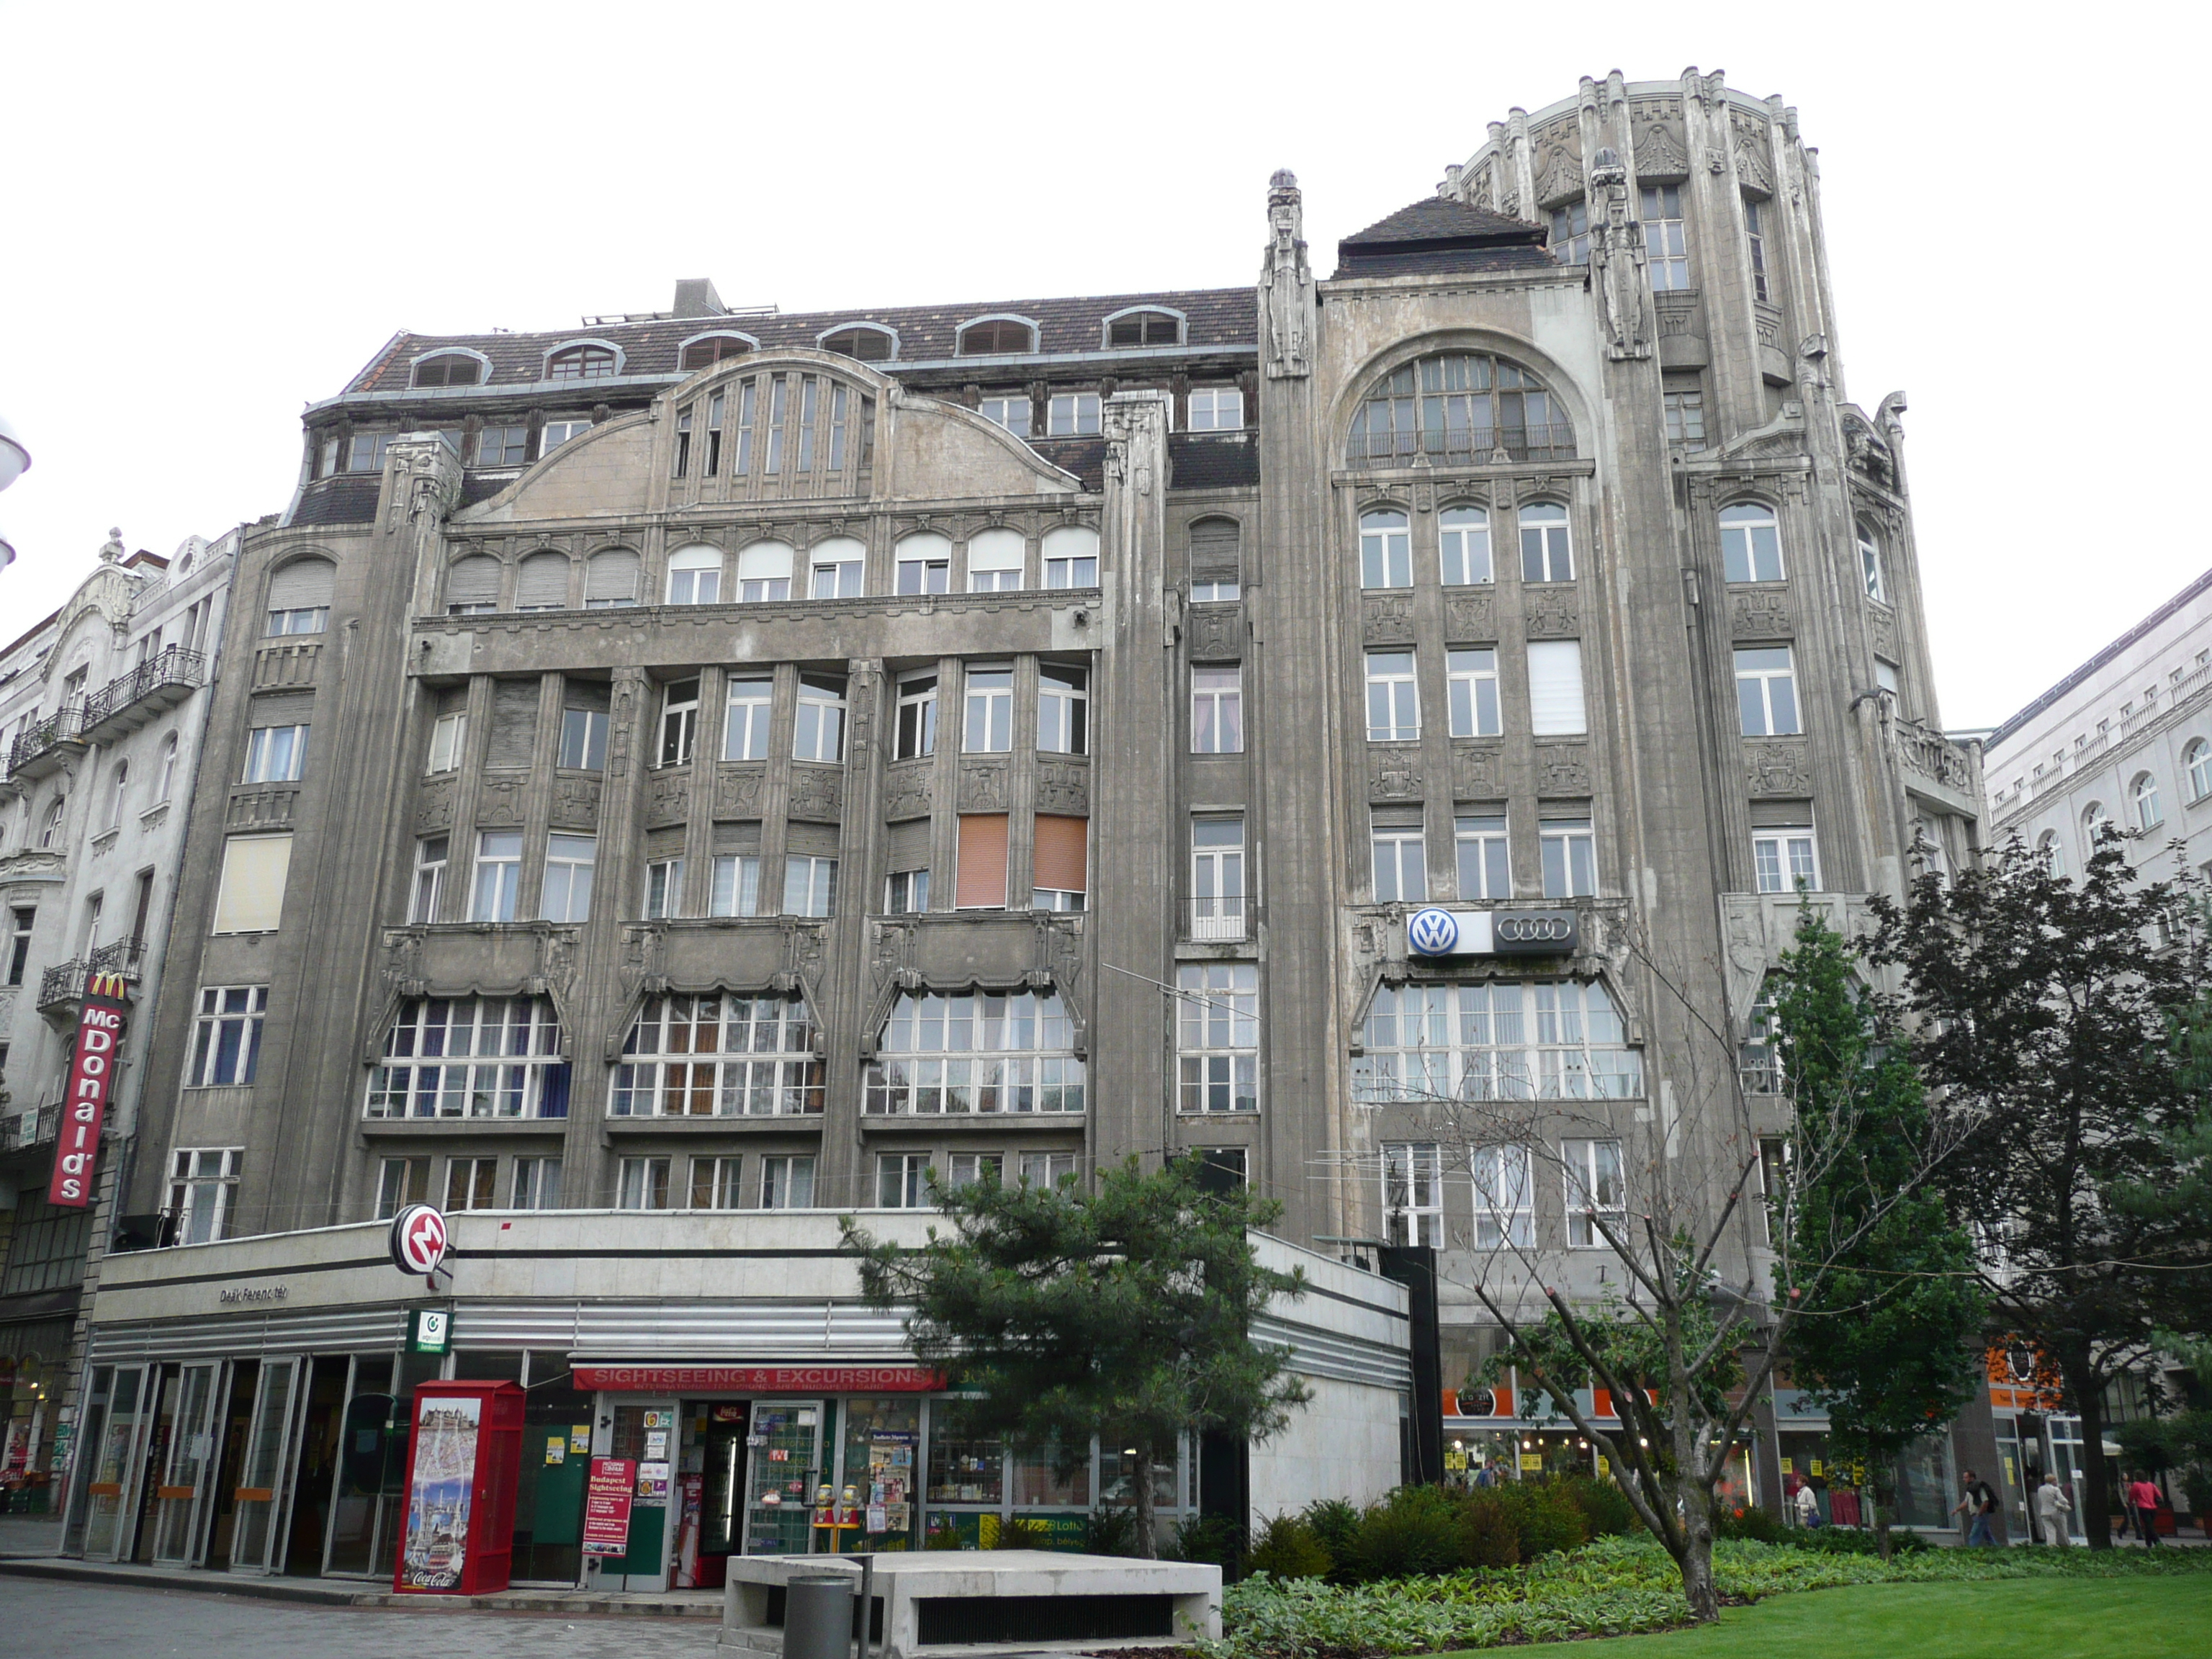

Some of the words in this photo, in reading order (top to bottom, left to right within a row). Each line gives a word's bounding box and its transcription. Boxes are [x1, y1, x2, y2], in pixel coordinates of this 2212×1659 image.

[594, 1369, 746, 1382] SIGHTSEEING
[753, 1369, 768, 1382] &
[776, 1369, 927, 1383] EXCURSIONS
[590, 1475, 626, 1484] Budapest
[590, 1484, 632, 1493] Sightseeing
